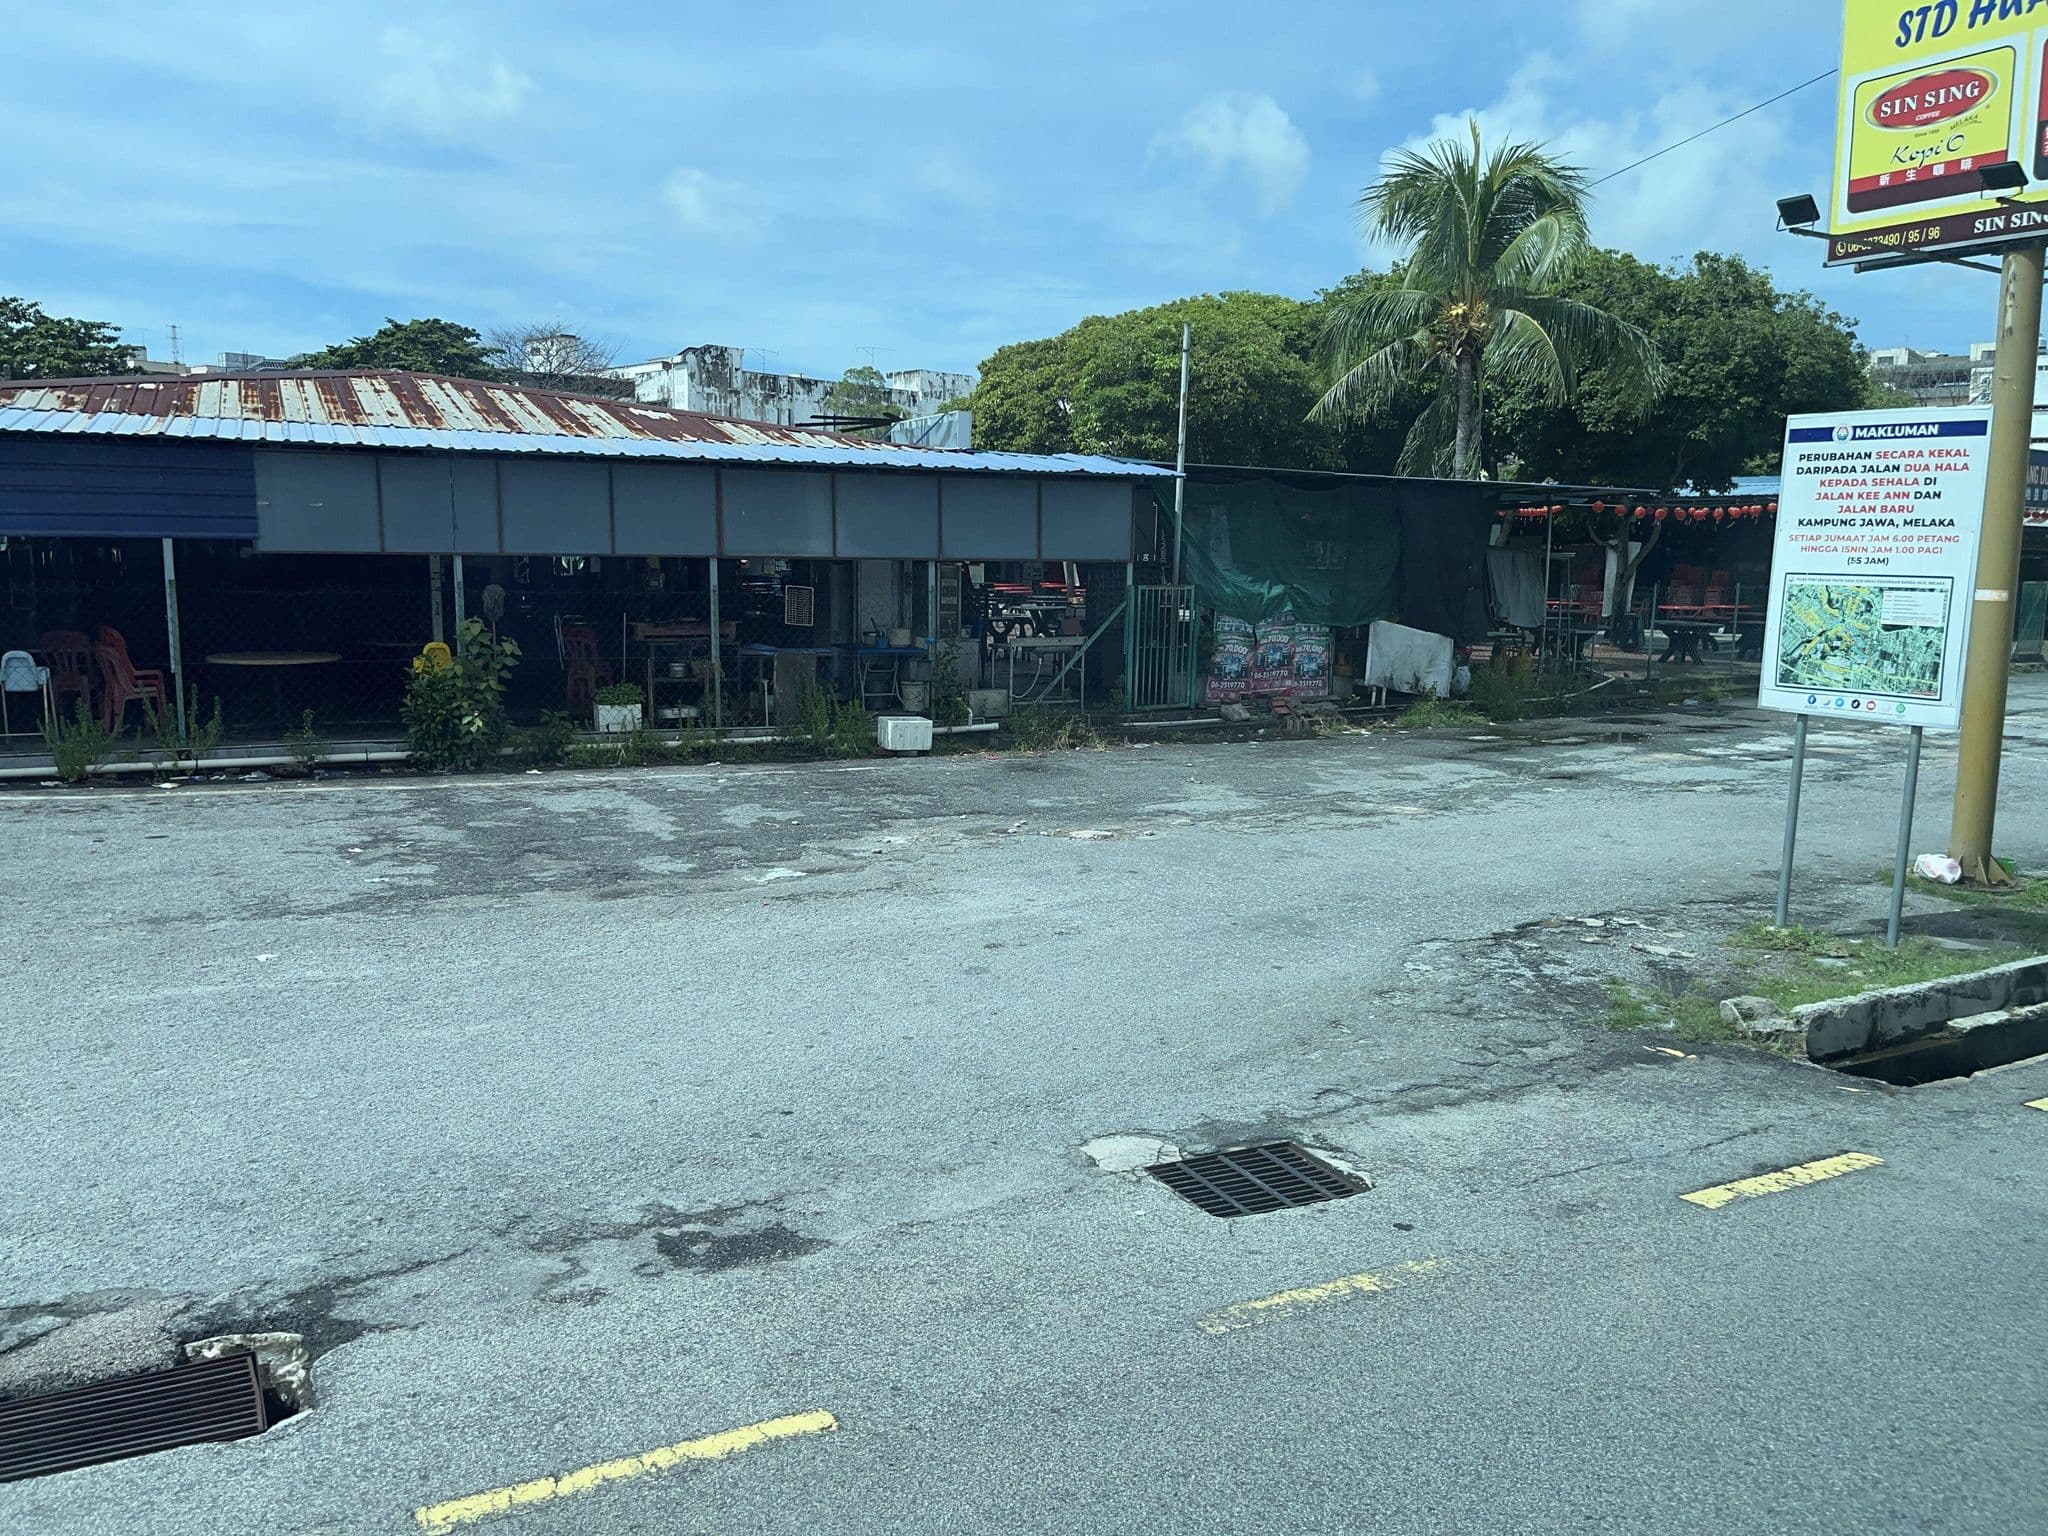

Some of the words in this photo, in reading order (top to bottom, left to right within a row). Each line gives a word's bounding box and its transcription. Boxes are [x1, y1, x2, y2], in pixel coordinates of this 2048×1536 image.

[1895, 0, 1958, 48] STD
[1880, 95, 1918, 118] SIN
[1924, 80, 1980, 108] SING
[1915, 110, 1941, 121] COFFEE
[1946, 134, 1965, 152] O
[1974, 215, 2007, 234] SIN
[1908, 229, 1921, 244] 95
[1927, 226, 1941, 240] 96
[1855, 424, 1939, 439] MAKLUMAN
[1799, 451, 1872, 462] PERUBAHAN
[1875, 449, 1924, 460] SECARA
[1928, 448, 1970, 458] KEKAL
[1796, 465, 1857, 475] DARIPADA
[1860, 464, 1900, 473] JALAN
[1904, 464, 1930, 472] DUA
[1934, 463, 1969, 471] HALA
[1819, 478, 1868, 488] KEPADA
[1871, 477, 1920, 487] SEHALA
[1924, 477, 1937, 486] DI
[1815, 492, 1854, 501] JALAN
[1857, 491, 1880, 500] KEE
[1884, 491, 1910, 500] ANN
[1914, 490, 1942, 500] DAN
[1837, 505, 1877, 514] JALAN
[1880, 505, 1915, 514] BARU
[1797, 518, 1857, 527] KAMPUNG
[1859, 518, 1899, 528] JAWA,
[1903, 518, 1956, 527] MELAKA
[1788, 534, 1822, 542] SETIAP
[1824, 534, 1866, 543] JUMAAT
[1868, 535, 1889, 543] JAM
[1893, 535, 1914, 543] 6.00
[1917, 535, 1960, 543] PETANG
[1801, 545, 1839, 553] HINGGA
[1842, 545, 1869, 553] ISNIN
[1871, 546, 1892, 554] JAM
[1896, 546, 1915, 554] 1.00
[1917, 547, 1943, 555] PAGI
[1847, 556, 1862, 566] (55
[1864, 557, 1889, 567] JAM)
